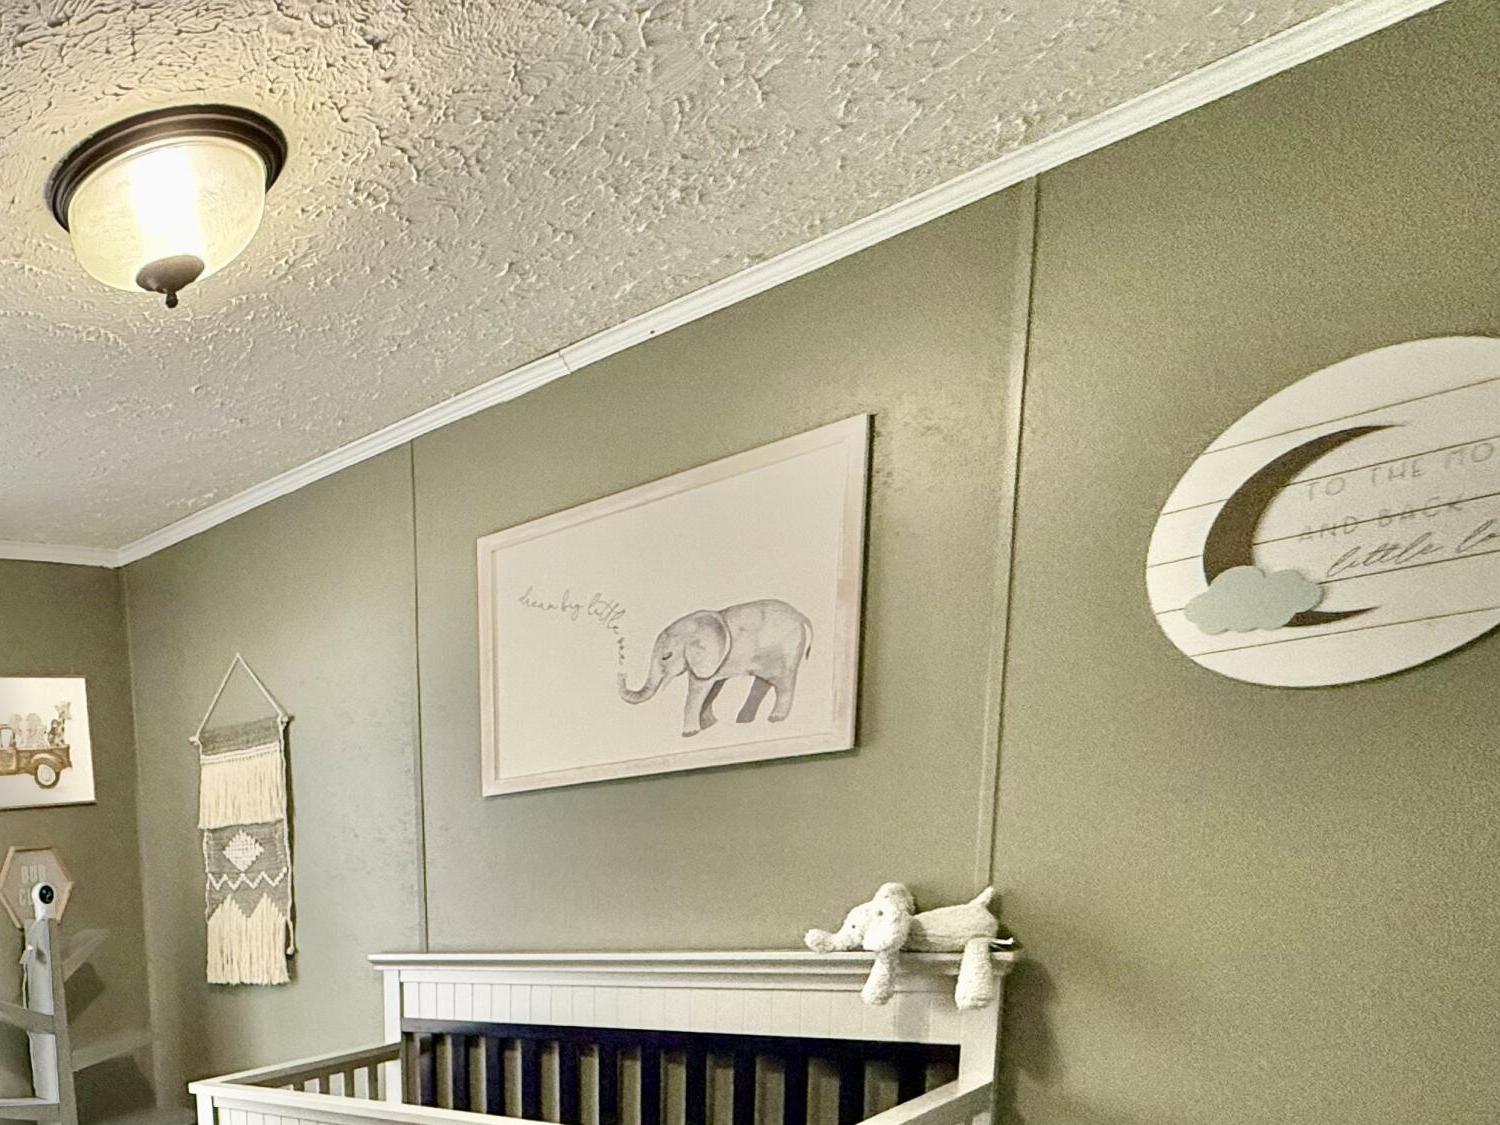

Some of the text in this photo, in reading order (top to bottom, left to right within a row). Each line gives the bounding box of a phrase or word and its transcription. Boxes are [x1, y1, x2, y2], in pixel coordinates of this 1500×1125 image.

[1306, 476, 1346, 502] TO
[1370, 458, 1424, 488] THE
[1299, 496, 1464, 544] AND BACK
[1326, 531, 1445, 578] little
